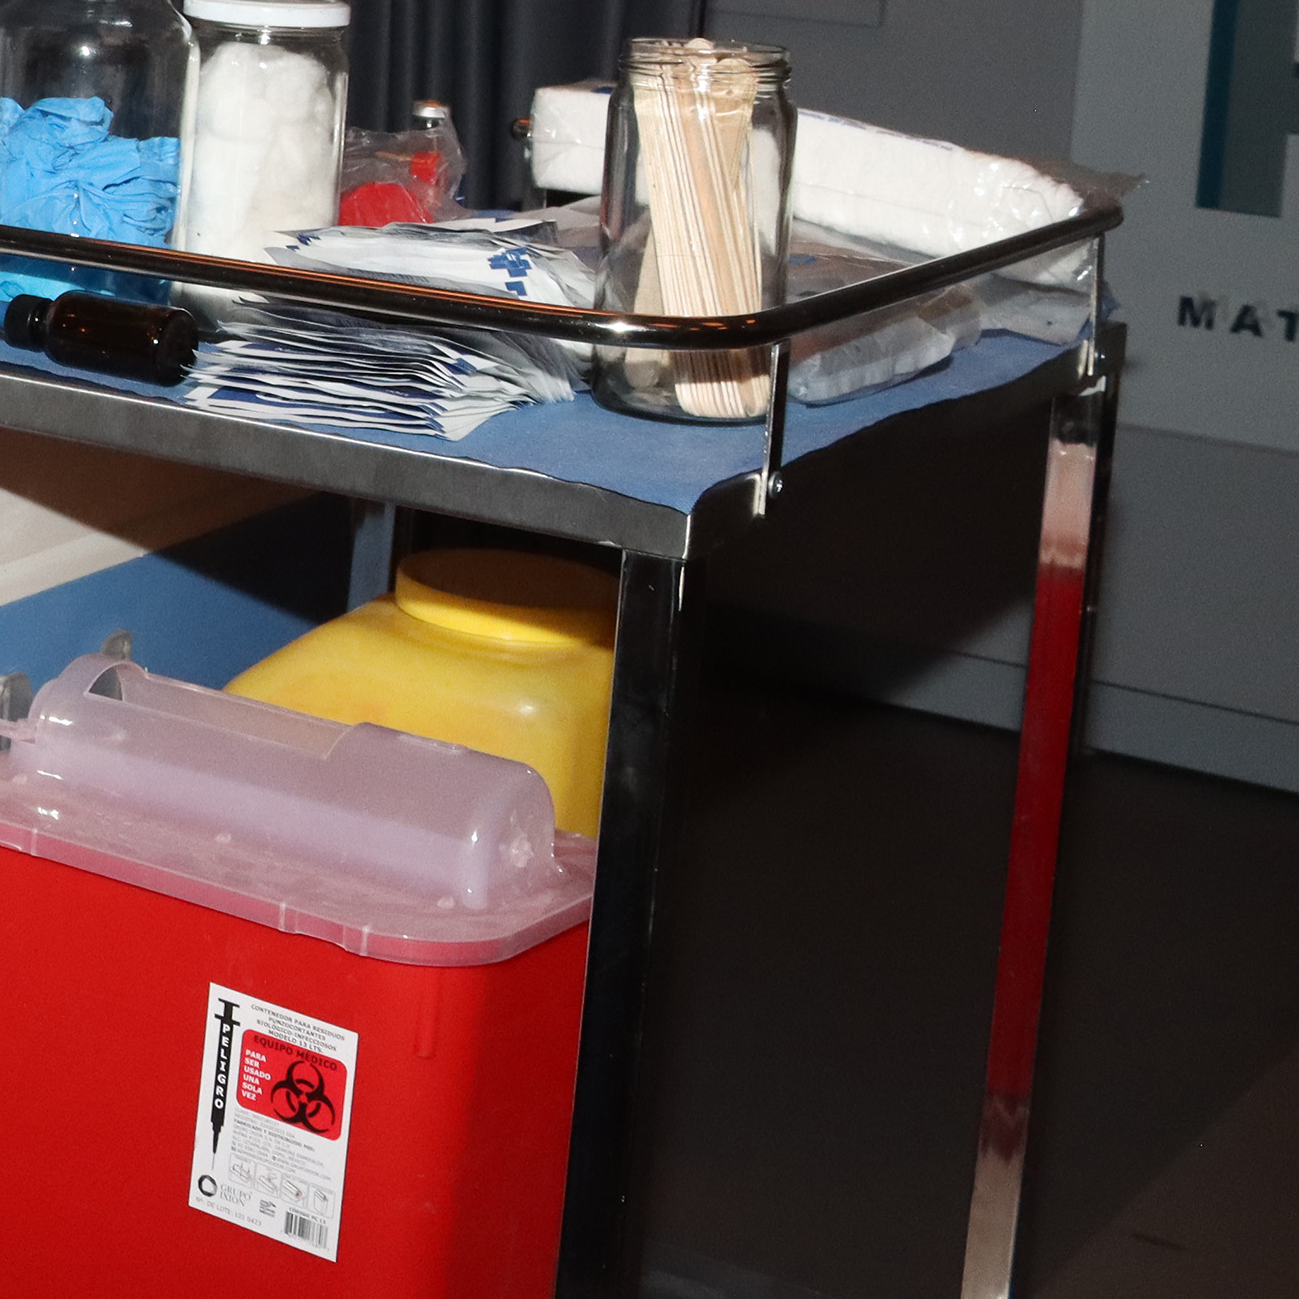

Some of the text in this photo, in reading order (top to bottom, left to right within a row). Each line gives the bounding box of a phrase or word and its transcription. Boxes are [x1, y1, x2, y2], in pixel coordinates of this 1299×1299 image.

[251, 1003, 345, 1041] CONTENEDOR PARA RESIDUOS
[268, 1029, 297, 1044] MODELO
[253, 1035, 293, 1056] EQUIPO
[244, 1057, 259, 1068] SER
[245, 1048, 266, 1062] PARA
[214, 1022, 230, 1110] PELIGRO
[243, 1065, 270, 1080] USADO
[242, 1073, 259, 1085] UNA
[241, 1089, 256, 1101] VEZ
[242, 1081, 262, 1094] SOLA
[220, 1183, 251, 1201] GRUPO
